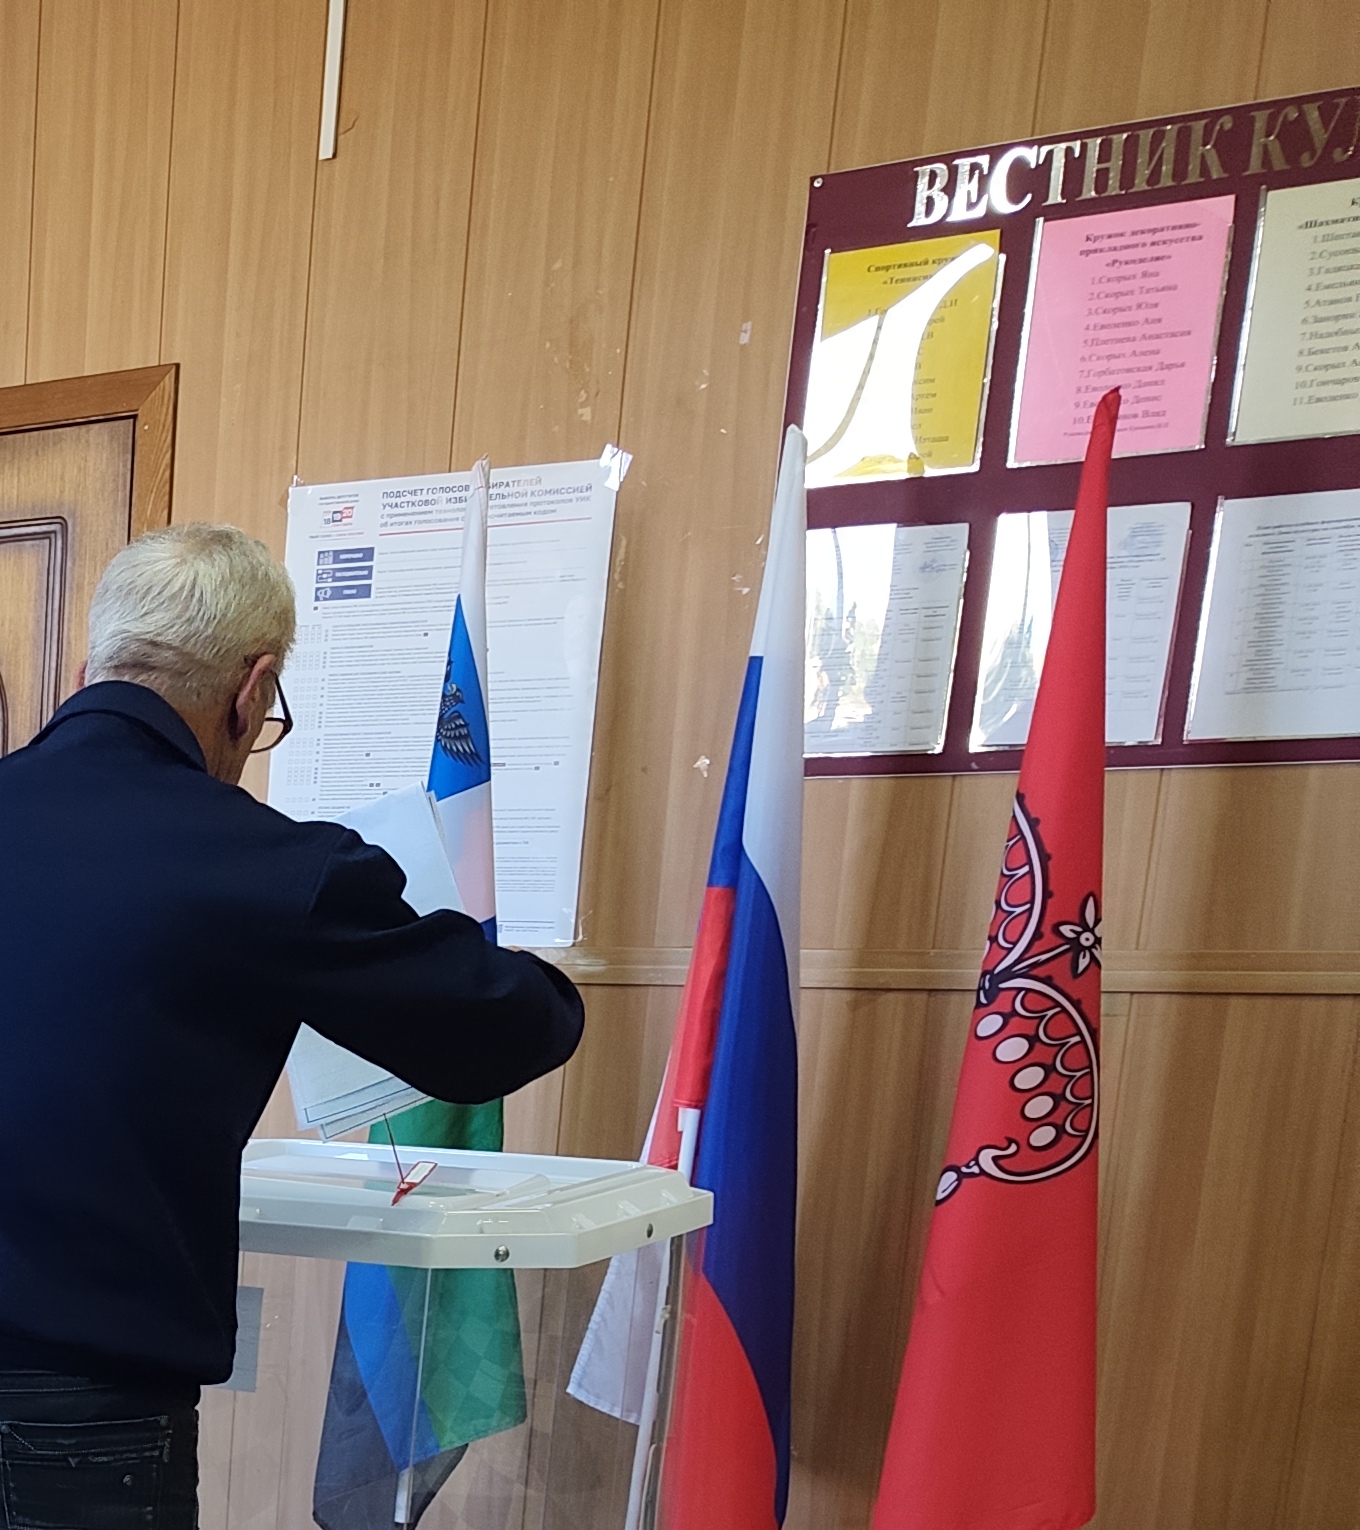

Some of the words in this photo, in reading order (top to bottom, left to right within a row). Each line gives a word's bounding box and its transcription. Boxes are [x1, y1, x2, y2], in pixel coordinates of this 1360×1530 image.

[907, 113, 1233, 228] ВЕСТНИК
[1080, 240, 1147, 256] прикладного
[1150, 233, 1204, 247] искусства
[1085, 230, 1126, 244] Кружок
[382, 487, 425, 500] ПОДСЧЕТ
[426, 484, 470, 496] ГОЛОСОВ
[530, 484, 593, 499] КОМИССИЕЙ
[530, 498, 574, 510] протоколов
